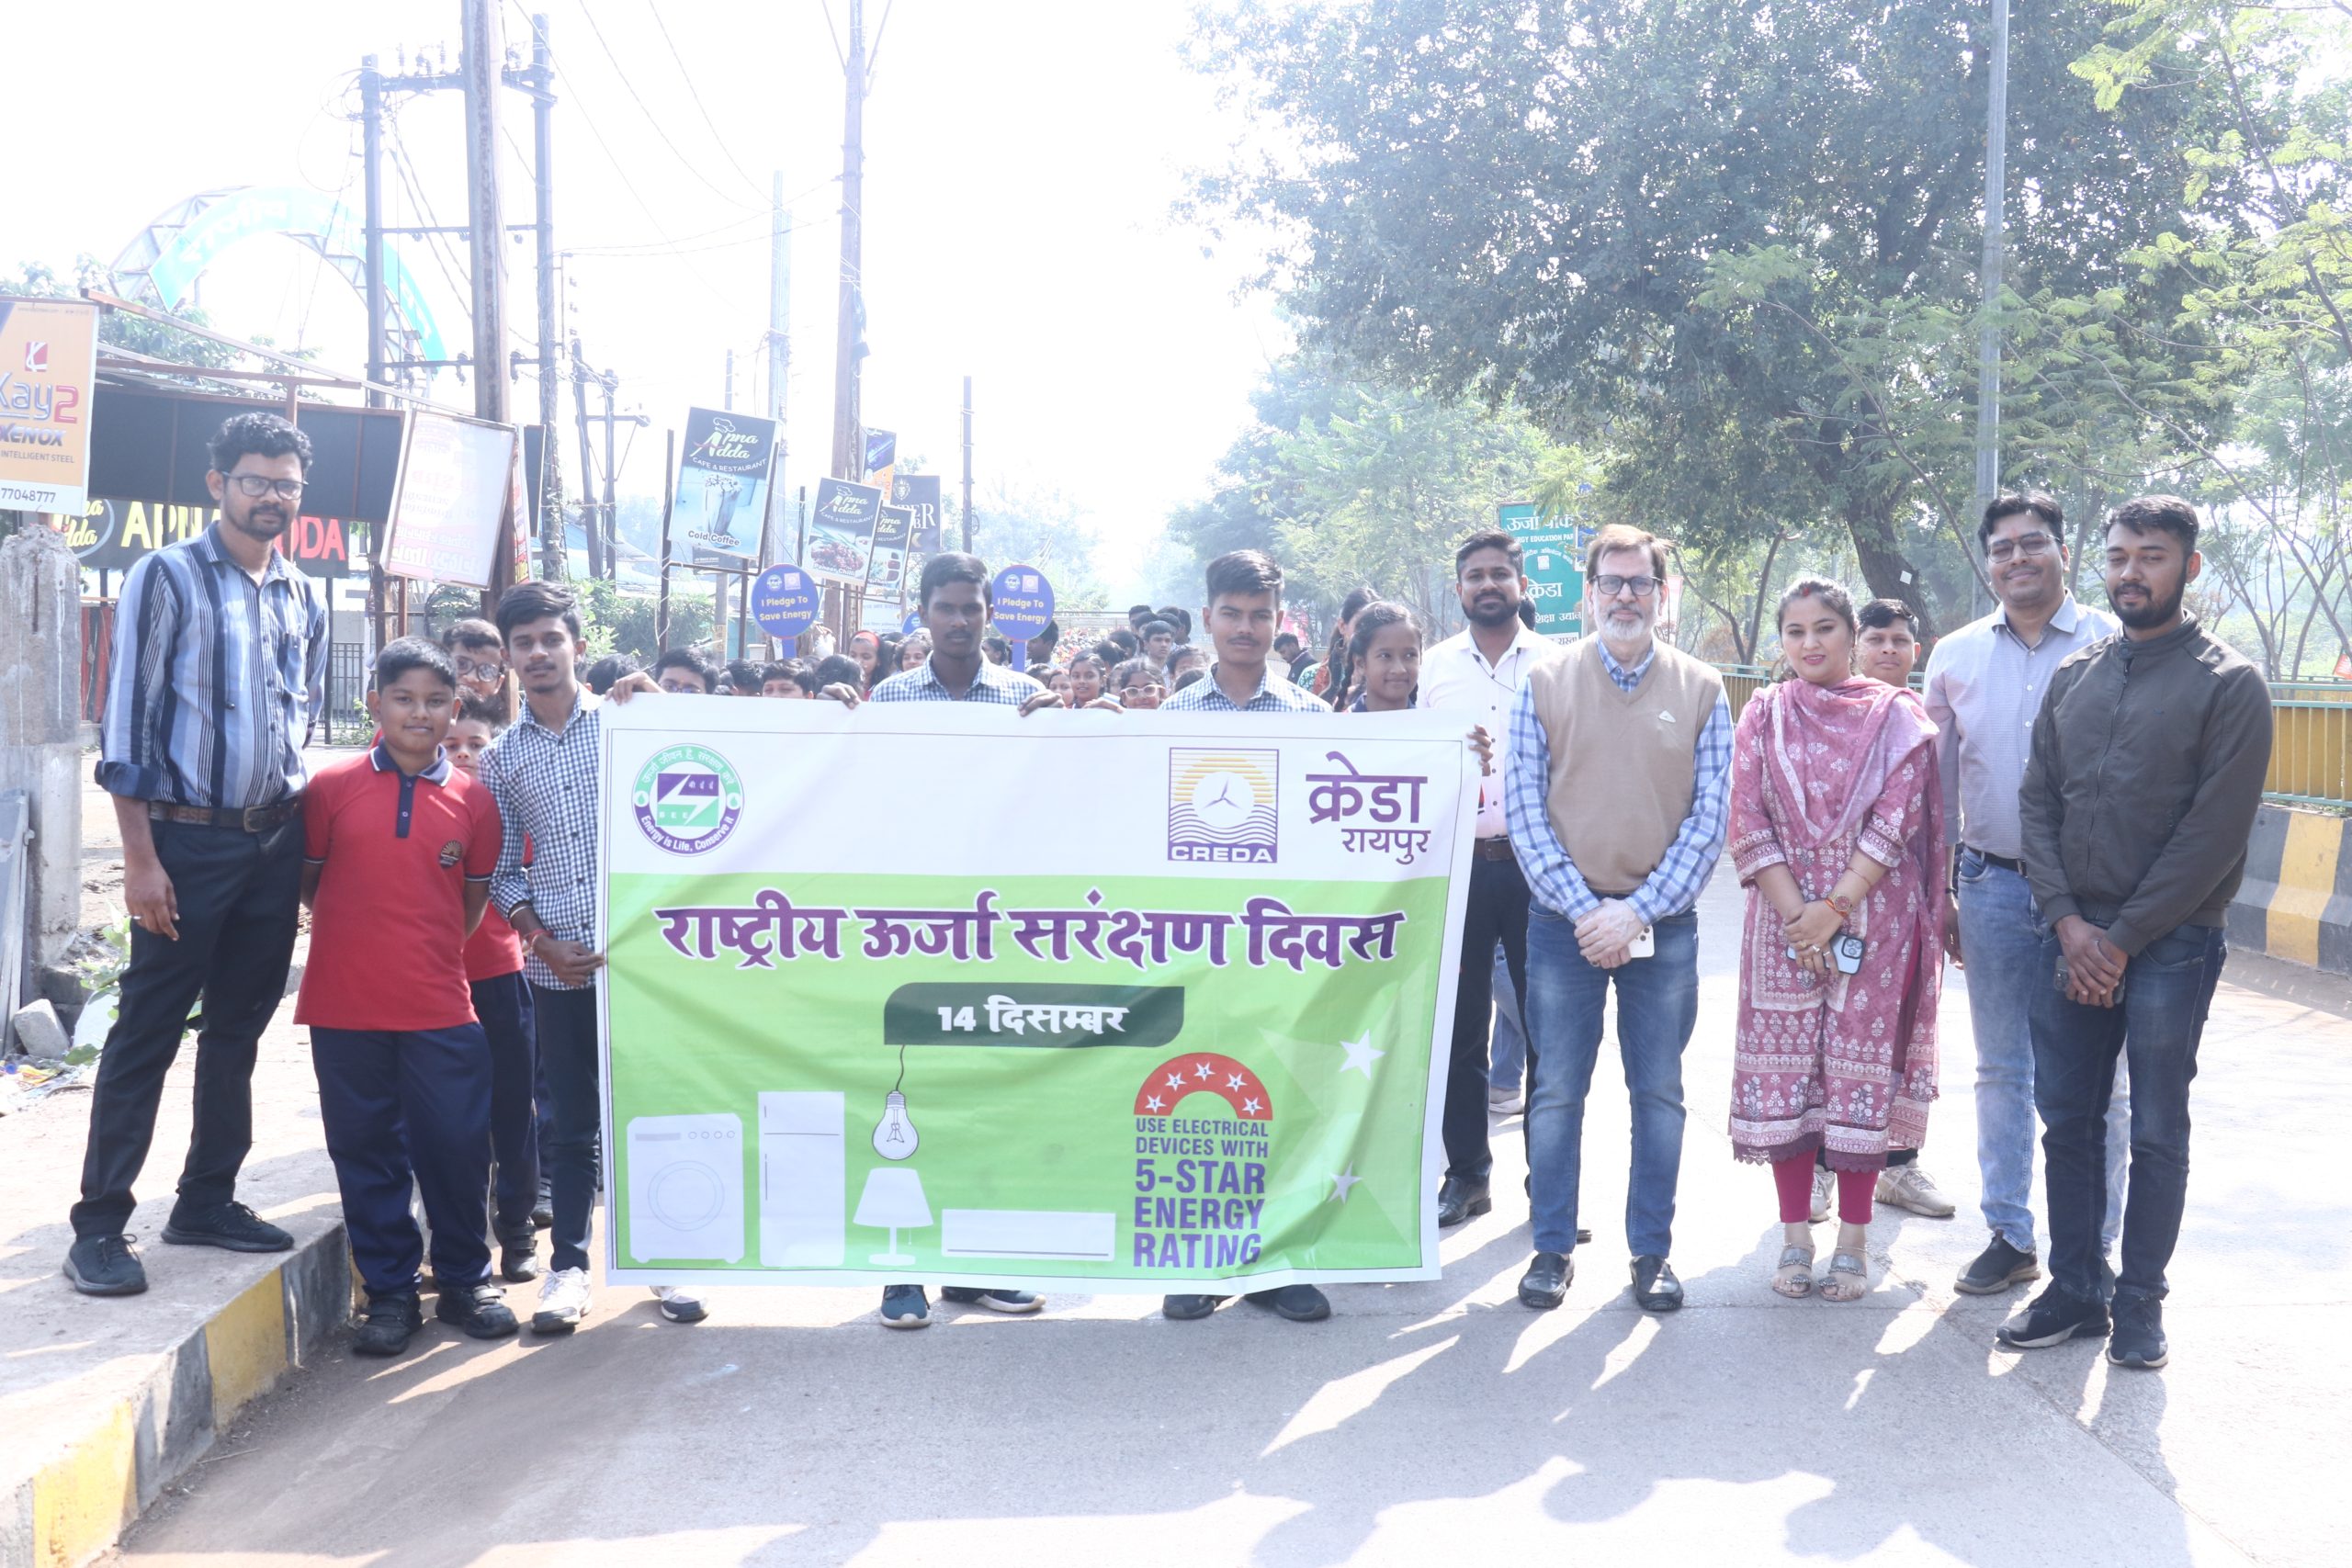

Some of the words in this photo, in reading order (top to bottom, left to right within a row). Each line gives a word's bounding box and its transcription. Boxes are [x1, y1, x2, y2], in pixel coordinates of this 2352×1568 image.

[0, 450, 50, 461] INTELLIGENT
[51, 454, 74, 463] STEEL
[693, 457, 711, 469] CAFE
[719, 458, 766, 472] RESTAURANT
[120, 501, 220, 549] APN
[688, 530, 708, 540] Cold
[711, 535, 740, 546] Coffee
[766, 596, 796, 607] Pledge
[797, 595, 808, 604] To
[1002, 597, 1031, 609] Pledge
[1033, 599, 1044, 608] To
[759, 613, 781, 622] Save
[783, 610, 812, 620] Energy
[994, 611, 1015, 621] Save
[1016, 612, 1046, 625] Energy
[1306, 750, 1428, 824] क्रेडा
[640, 814, 664, 844] Energy
[663, 836, 673, 848] is
[695, 824, 730, 851] Conserve
[1170, 846, 1273, 863] CREDA
[1340, 829, 1431, 864] रायपुर
[654, 888, 849, 969] राष्ट्रीय
[854, 889, 1001, 961] ऊर्जा
[1239, 897, 1406, 972] दिवस
[937, 1006, 977, 1032] 14
[983, 994, 1130, 1036] दिसम्बर
[1136, 1118, 1167, 1133] USE
[1172, 1119, 1269, 1137] ELECTRICAL
[1136, 1136, 1215, 1156] DEVICES
[1221, 1139, 1268, 1157] WITH
[1135, 1158, 1266, 1195] 5-STAR
[1134, 1196, 1265, 1230] ENERGY
[1133, 1232, 1262, 1269] RATING
